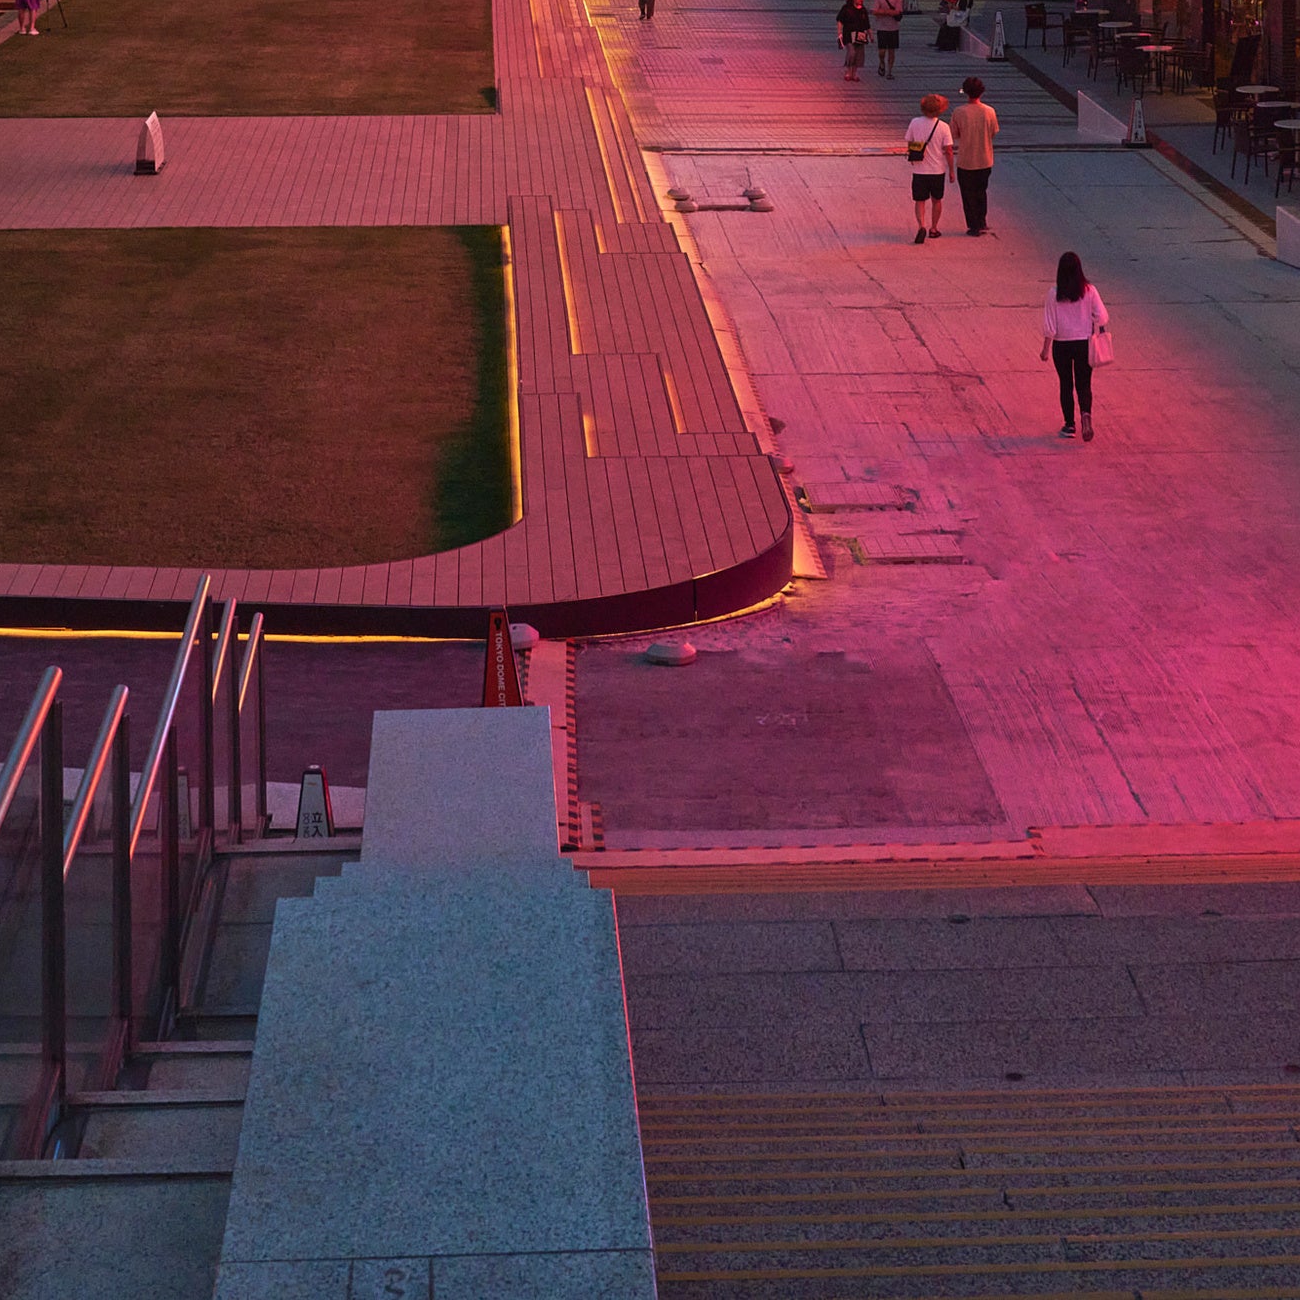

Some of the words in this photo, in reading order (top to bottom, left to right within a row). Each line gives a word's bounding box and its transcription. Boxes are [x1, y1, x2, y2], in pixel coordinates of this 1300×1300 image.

[495, 632, 504, 662] TOKYO
[497, 664, 505, 691] DOME
[498, 692, 506, 706] CIT
[312, 812, 323, 837] 立入
